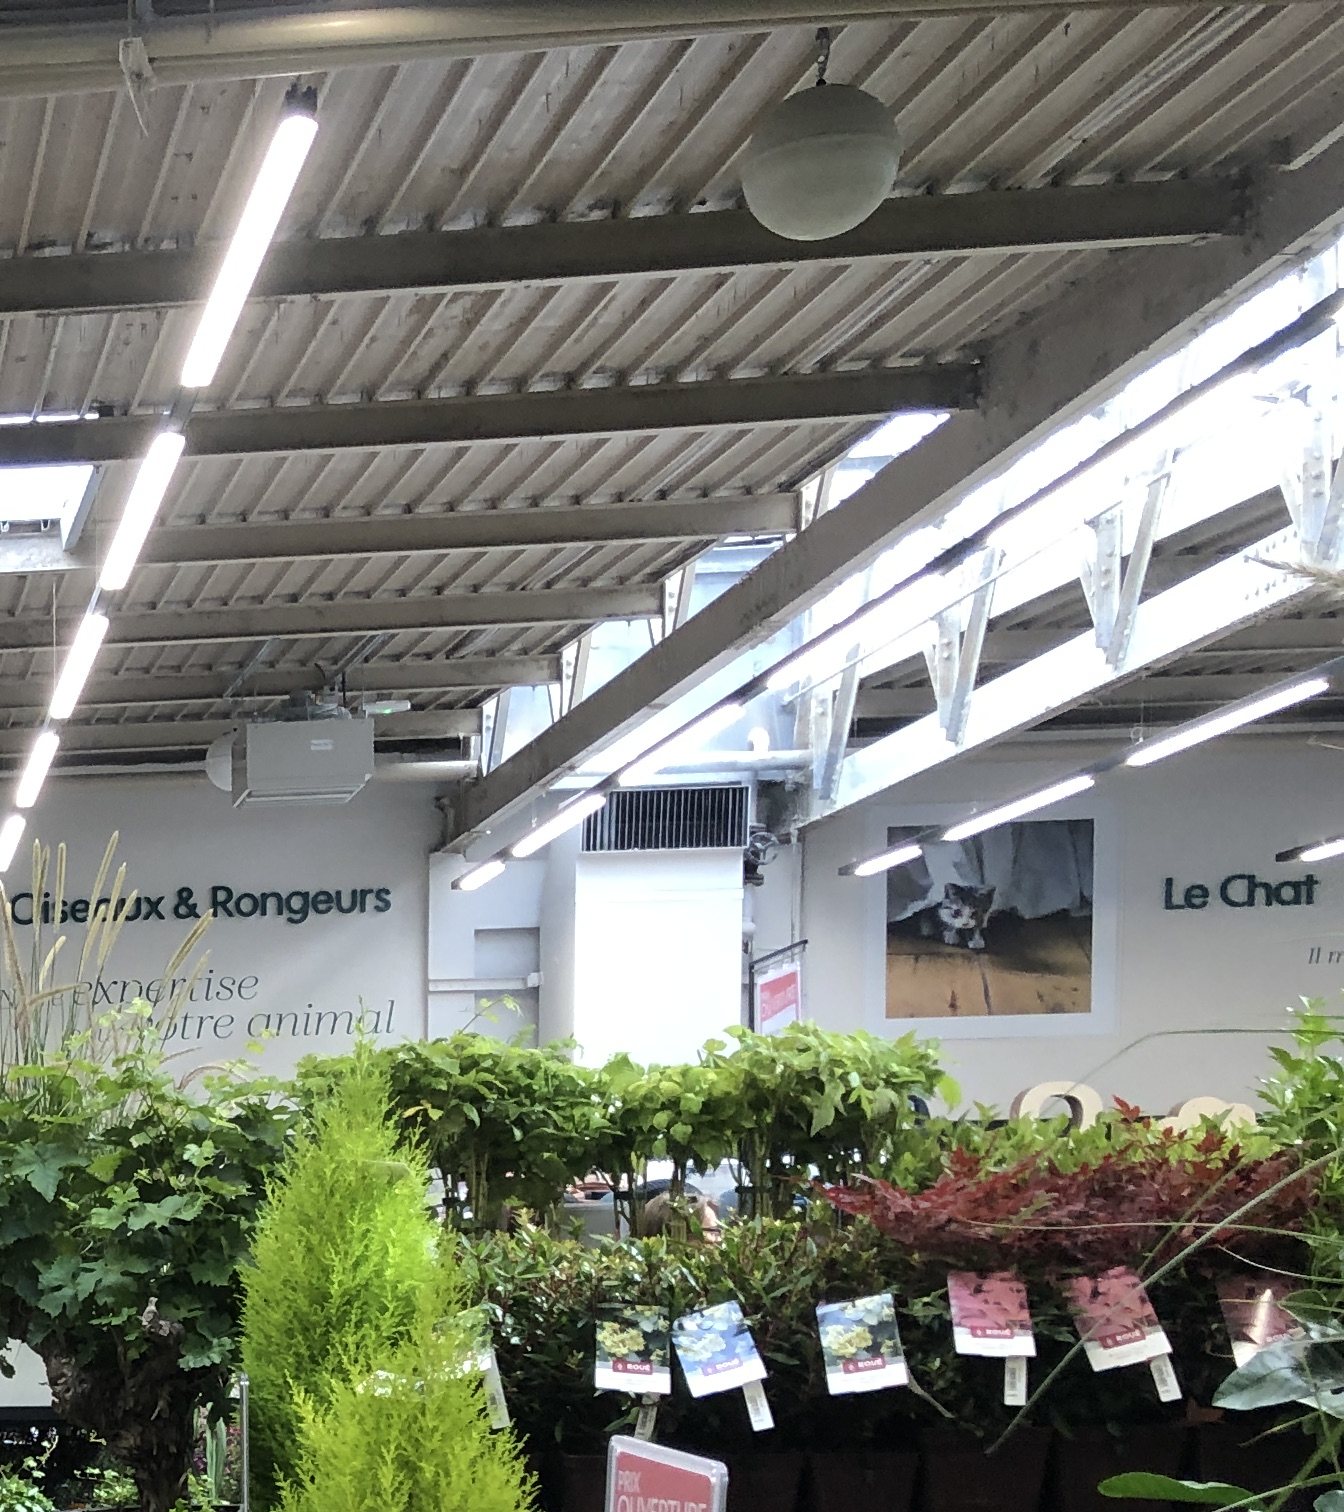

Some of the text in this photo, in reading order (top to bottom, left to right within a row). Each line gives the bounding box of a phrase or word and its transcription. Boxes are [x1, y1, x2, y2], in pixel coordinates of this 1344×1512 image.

[173, 887, 202, 921] &
[212, 884, 392, 924] Rongeurs
[1164, 874, 1320, 910] Le Chat
[247, 999, 395, 1042] animal
[617, 1470, 641, 1494] PRIX
